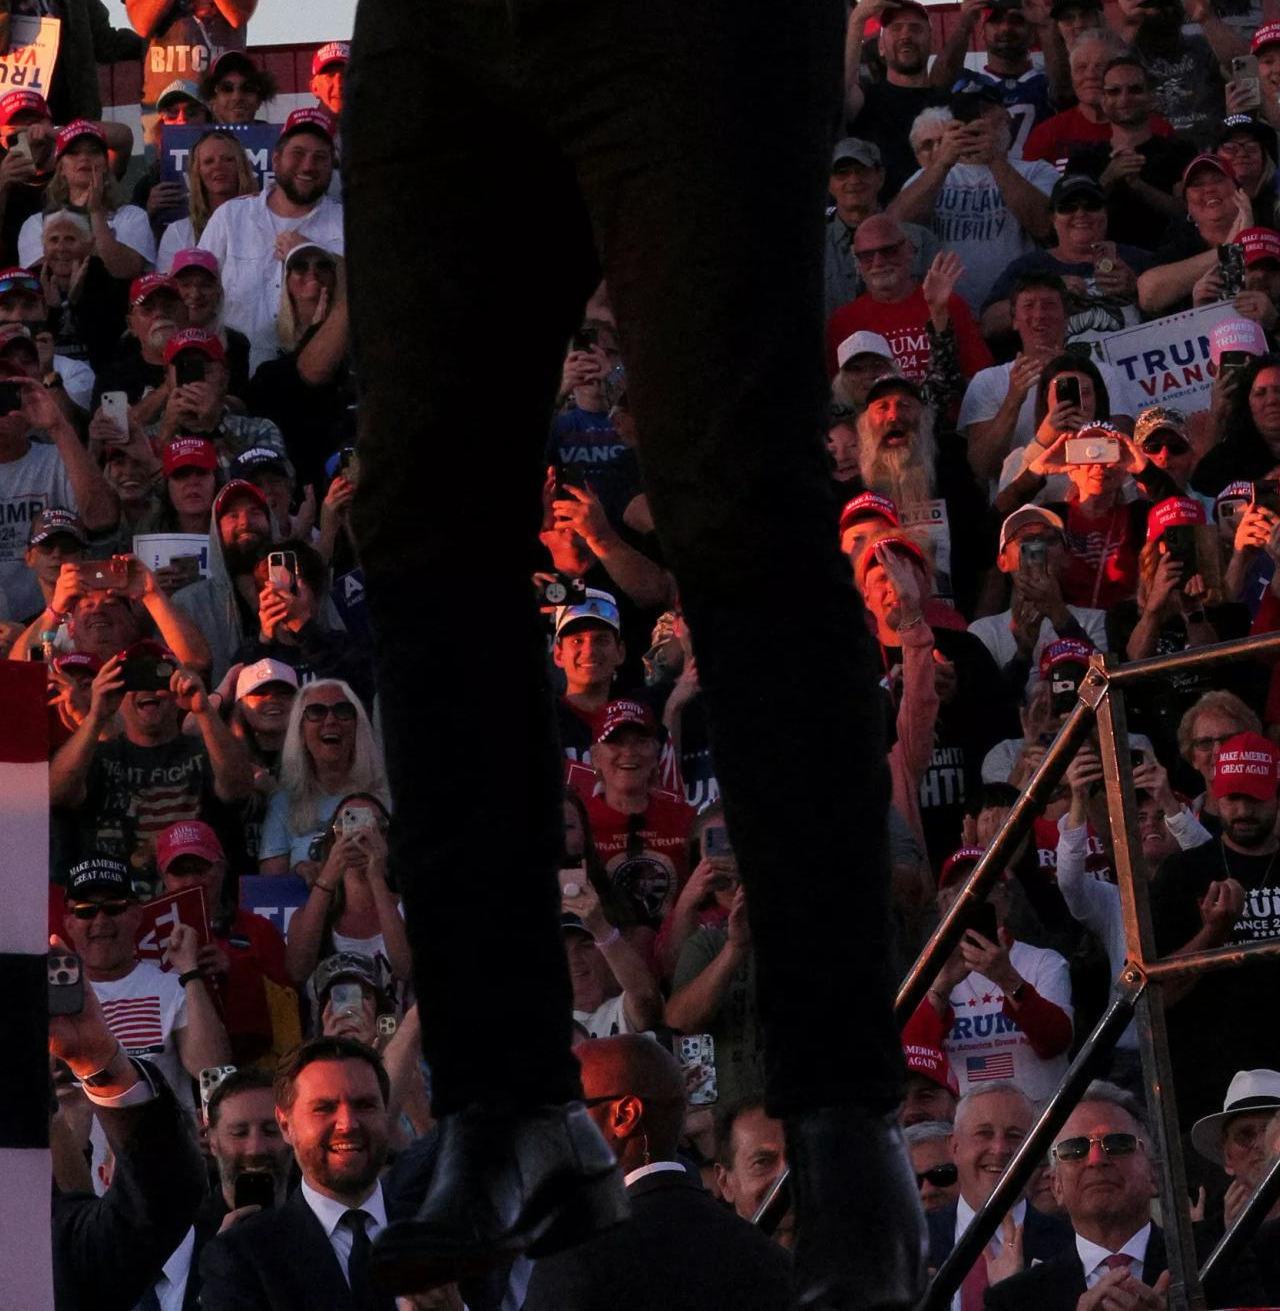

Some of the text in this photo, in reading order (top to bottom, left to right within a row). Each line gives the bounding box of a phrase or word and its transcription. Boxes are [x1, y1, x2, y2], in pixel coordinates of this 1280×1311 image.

[1217, 333, 1256, 348] TRUMP
[1138, 363, 1217, 397] VANC
[1138, 387, 1197, 407] MAKE AMERICA
[237, 447, 278, 464] TRUMP
[559, 445, 626, 464] VANC
[606, 701, 644, 714] Trump
[928, 747, 964, 767] GHT!
[1219, 751, 1273, 764] MAKE AMERICA
[149, 754, 204, 783] FIGHT
[1221, 764, 1270, 776] GREAT AGAIN
[920, 767, 966, 808] HT!
[69, 858, 128, 877] MAKE AMERICA
[74, 870, 123, 887] GREAT AGAIN
[1233, 918, 1269, 931] ANCE
[952, 1012, 1024, 1040] RUM
[904, 1045, 943, 1061] MERICA
[958, 1038, 1018, 1051] America Great
[907, 1056, 938, 1070] AGAIN
